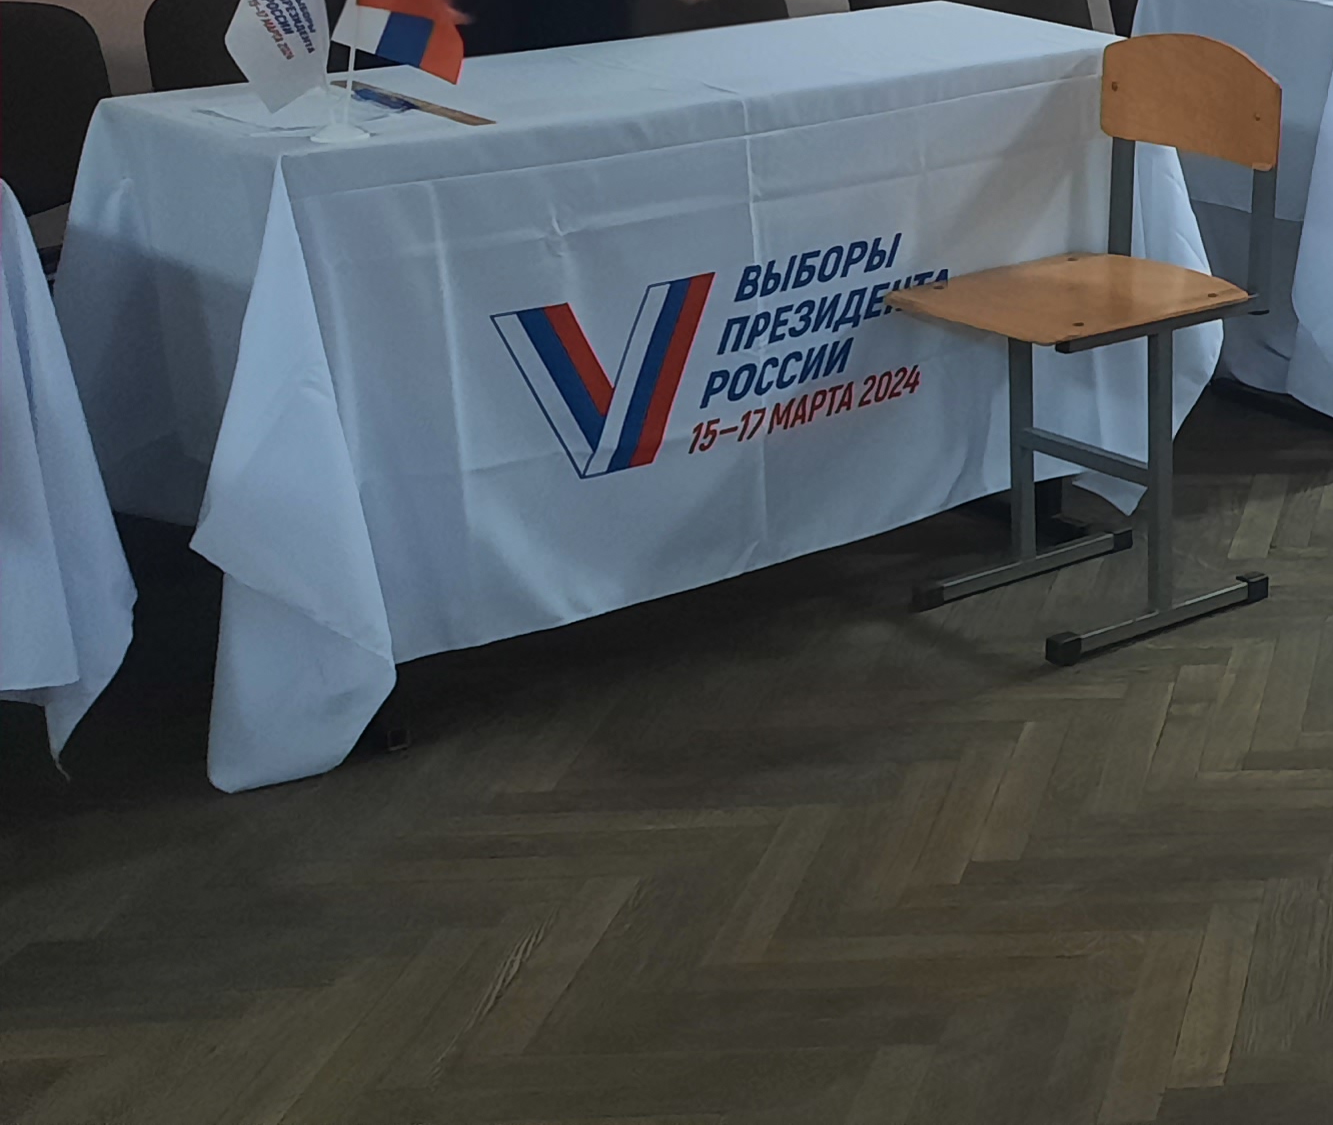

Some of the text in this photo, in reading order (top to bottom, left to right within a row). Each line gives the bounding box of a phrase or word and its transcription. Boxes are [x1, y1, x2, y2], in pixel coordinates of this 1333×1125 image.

[733, 232, 902, 303] ВЫБОРЫ
[699, 337, 855, 410] РОССИИ
[767, 381, 853, 435] МАРТА
[858, 364, 922, 408] 2024
